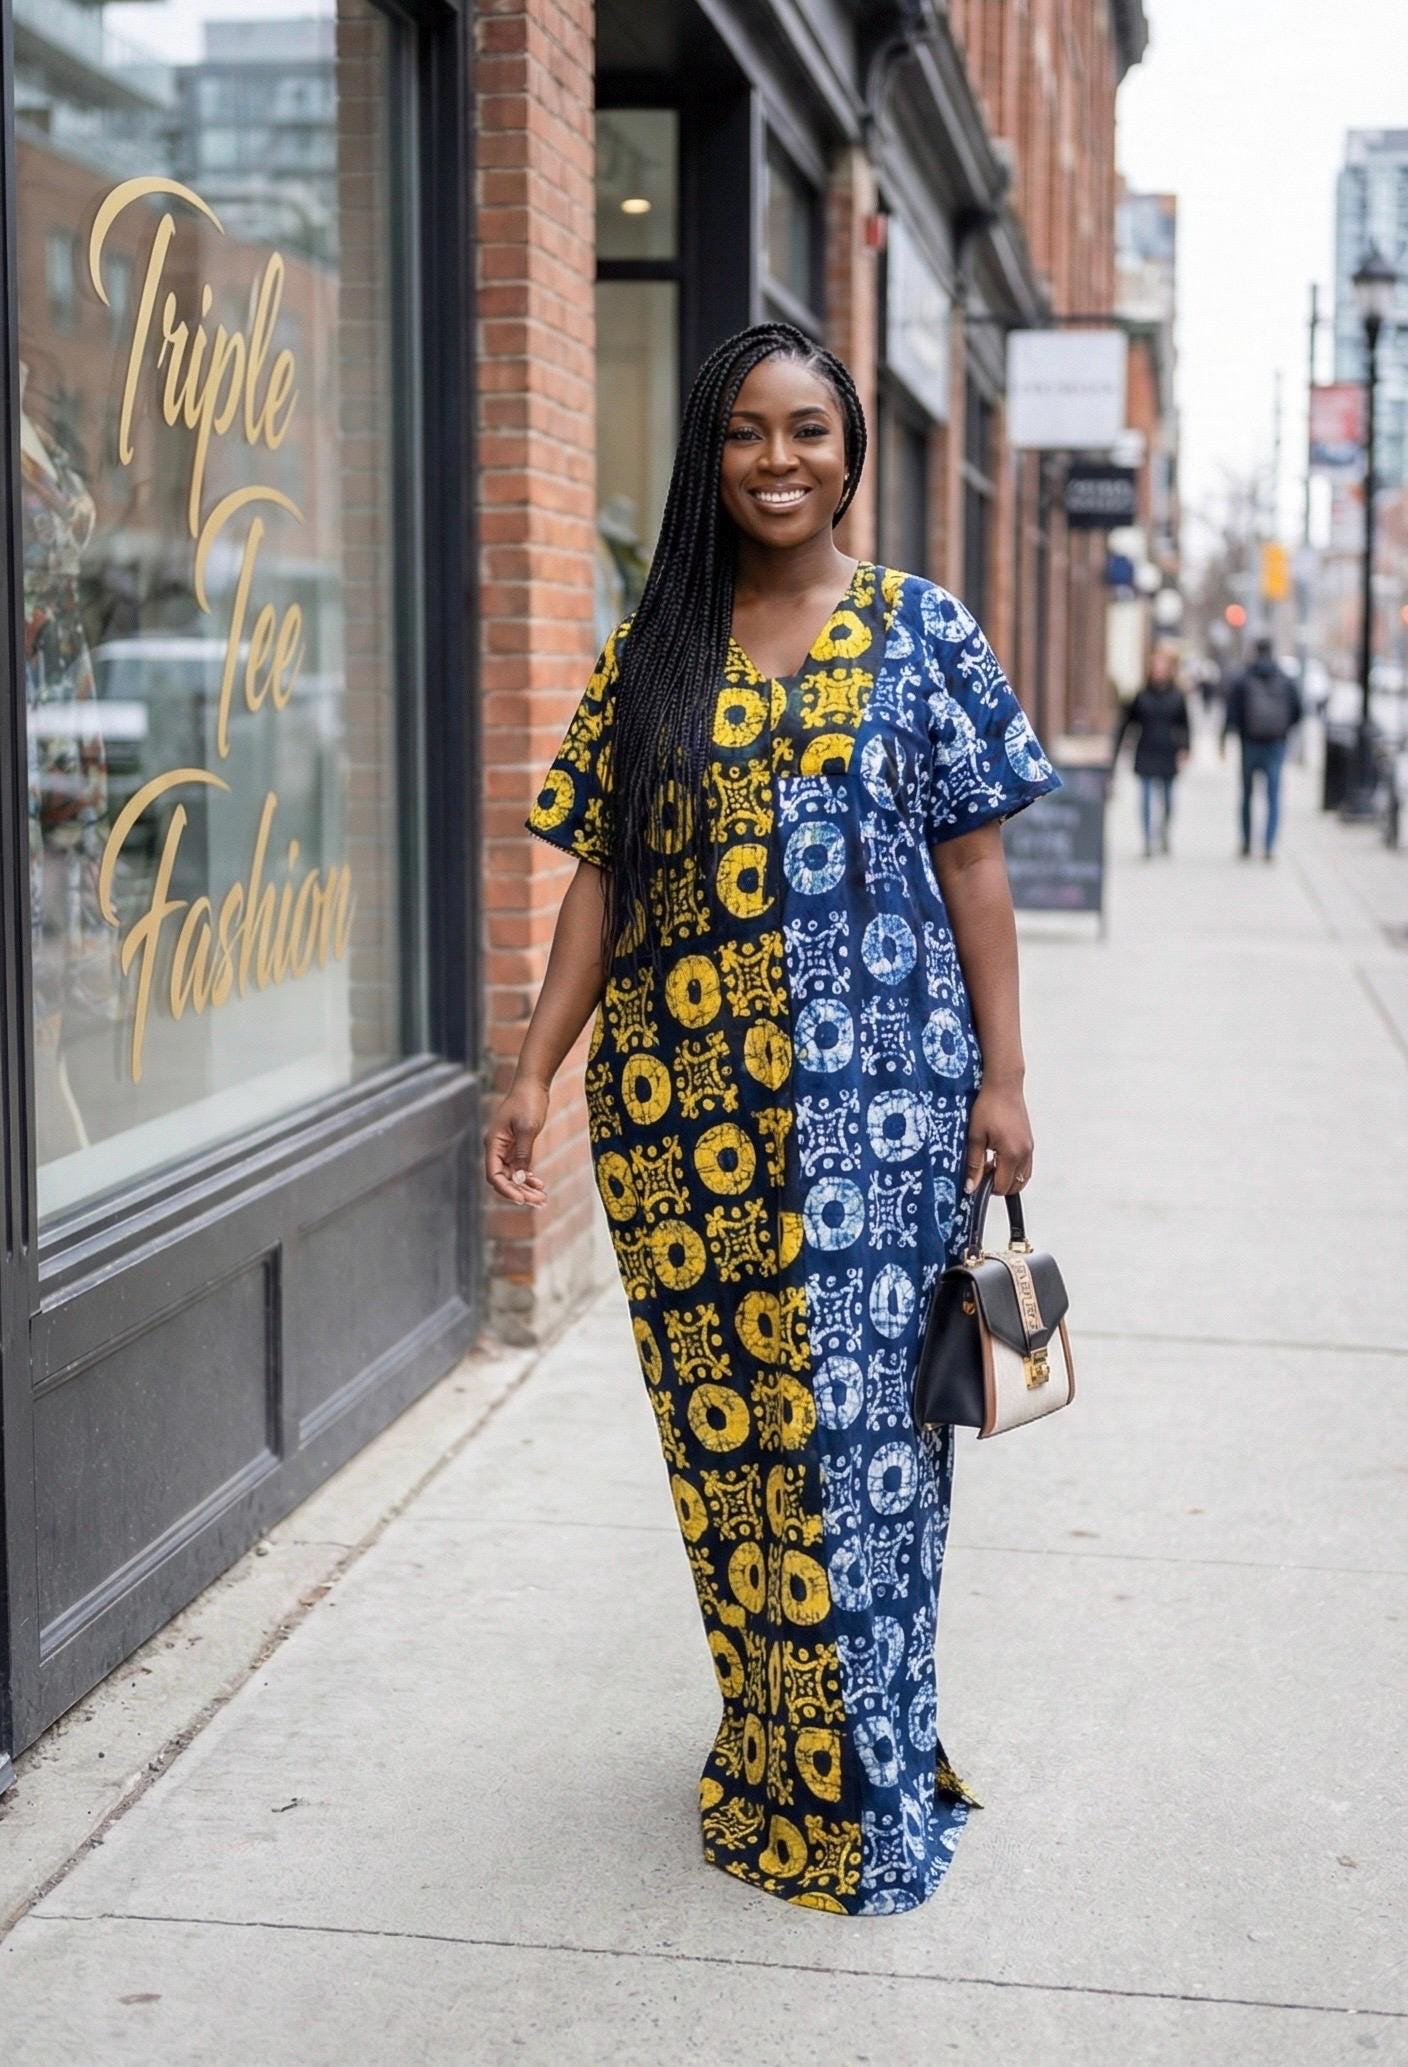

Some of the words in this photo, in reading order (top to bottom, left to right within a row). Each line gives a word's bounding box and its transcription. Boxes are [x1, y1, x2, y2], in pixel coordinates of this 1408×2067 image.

[89, 175, 297, 539] Triple
[195, 485, 305, 759] Tee
[100, 768, 356, 1085] Fashion
